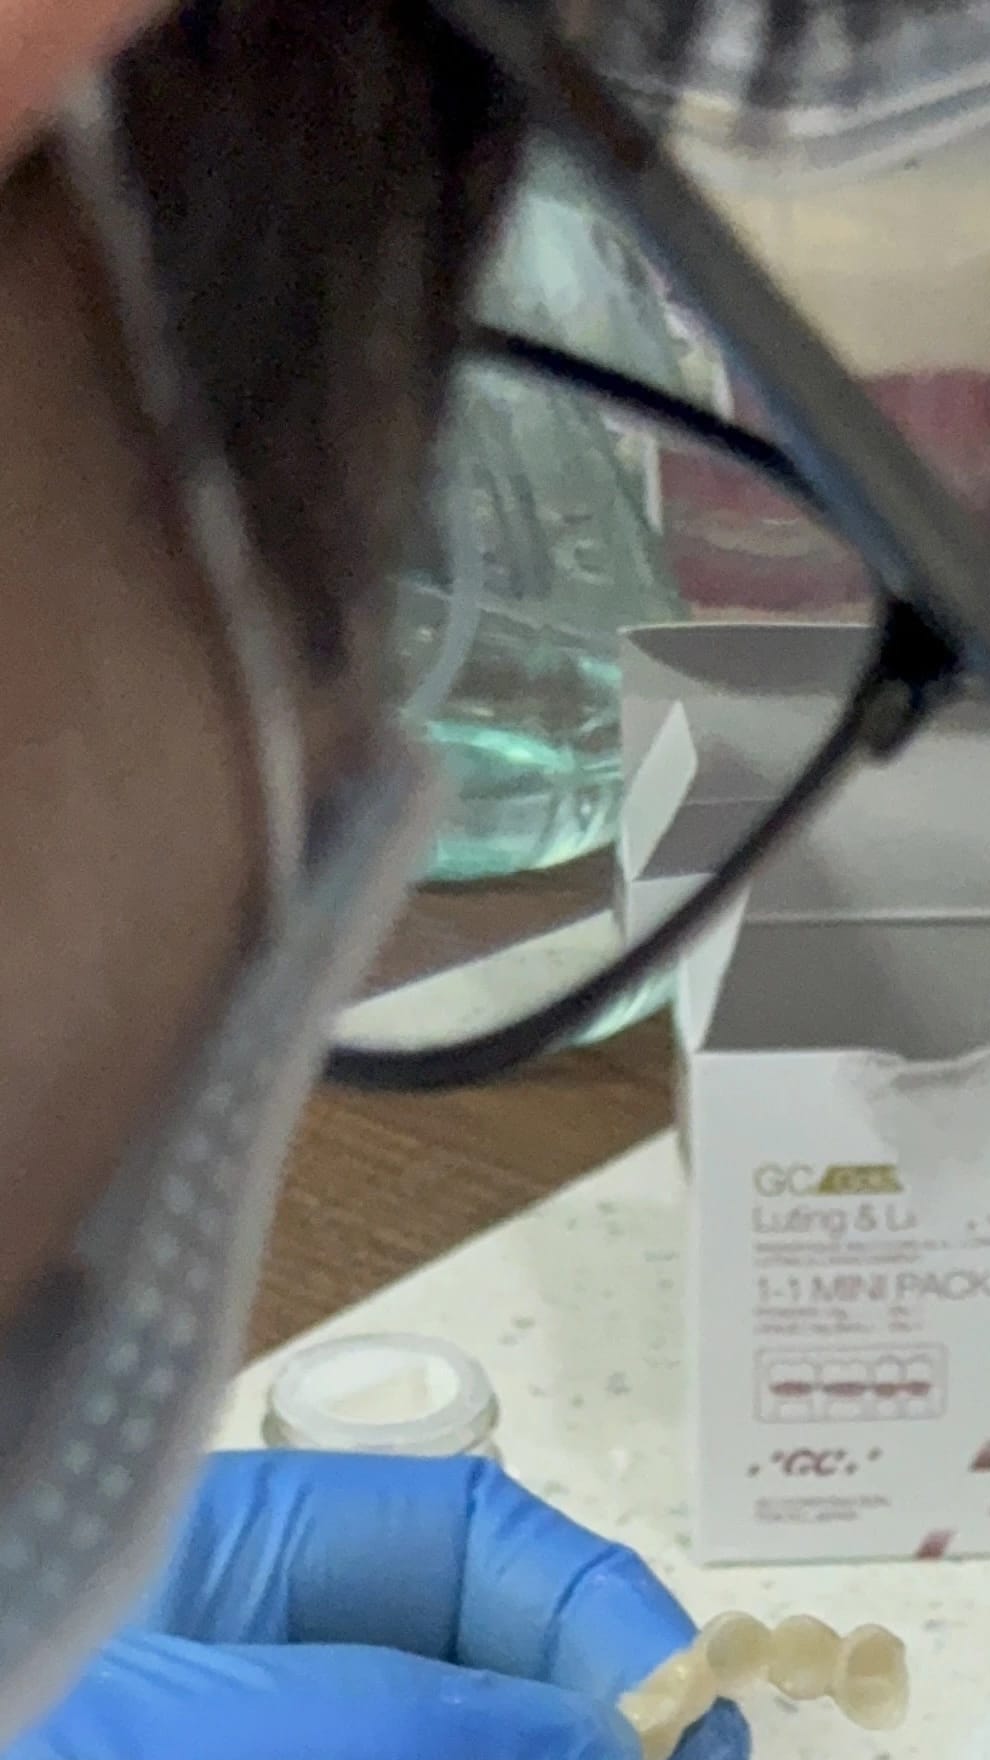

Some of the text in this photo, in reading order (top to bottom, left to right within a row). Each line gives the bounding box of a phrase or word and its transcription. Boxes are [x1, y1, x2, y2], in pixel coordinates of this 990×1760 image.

[753, 1163, 813, 1197] GC
[753, 1203, 848, 1239] Luting
[853, 1203, 877, 1232] &
[757, 1274, 802, 1303] 1-1
[812, 1273, 888, 1303] MINI
